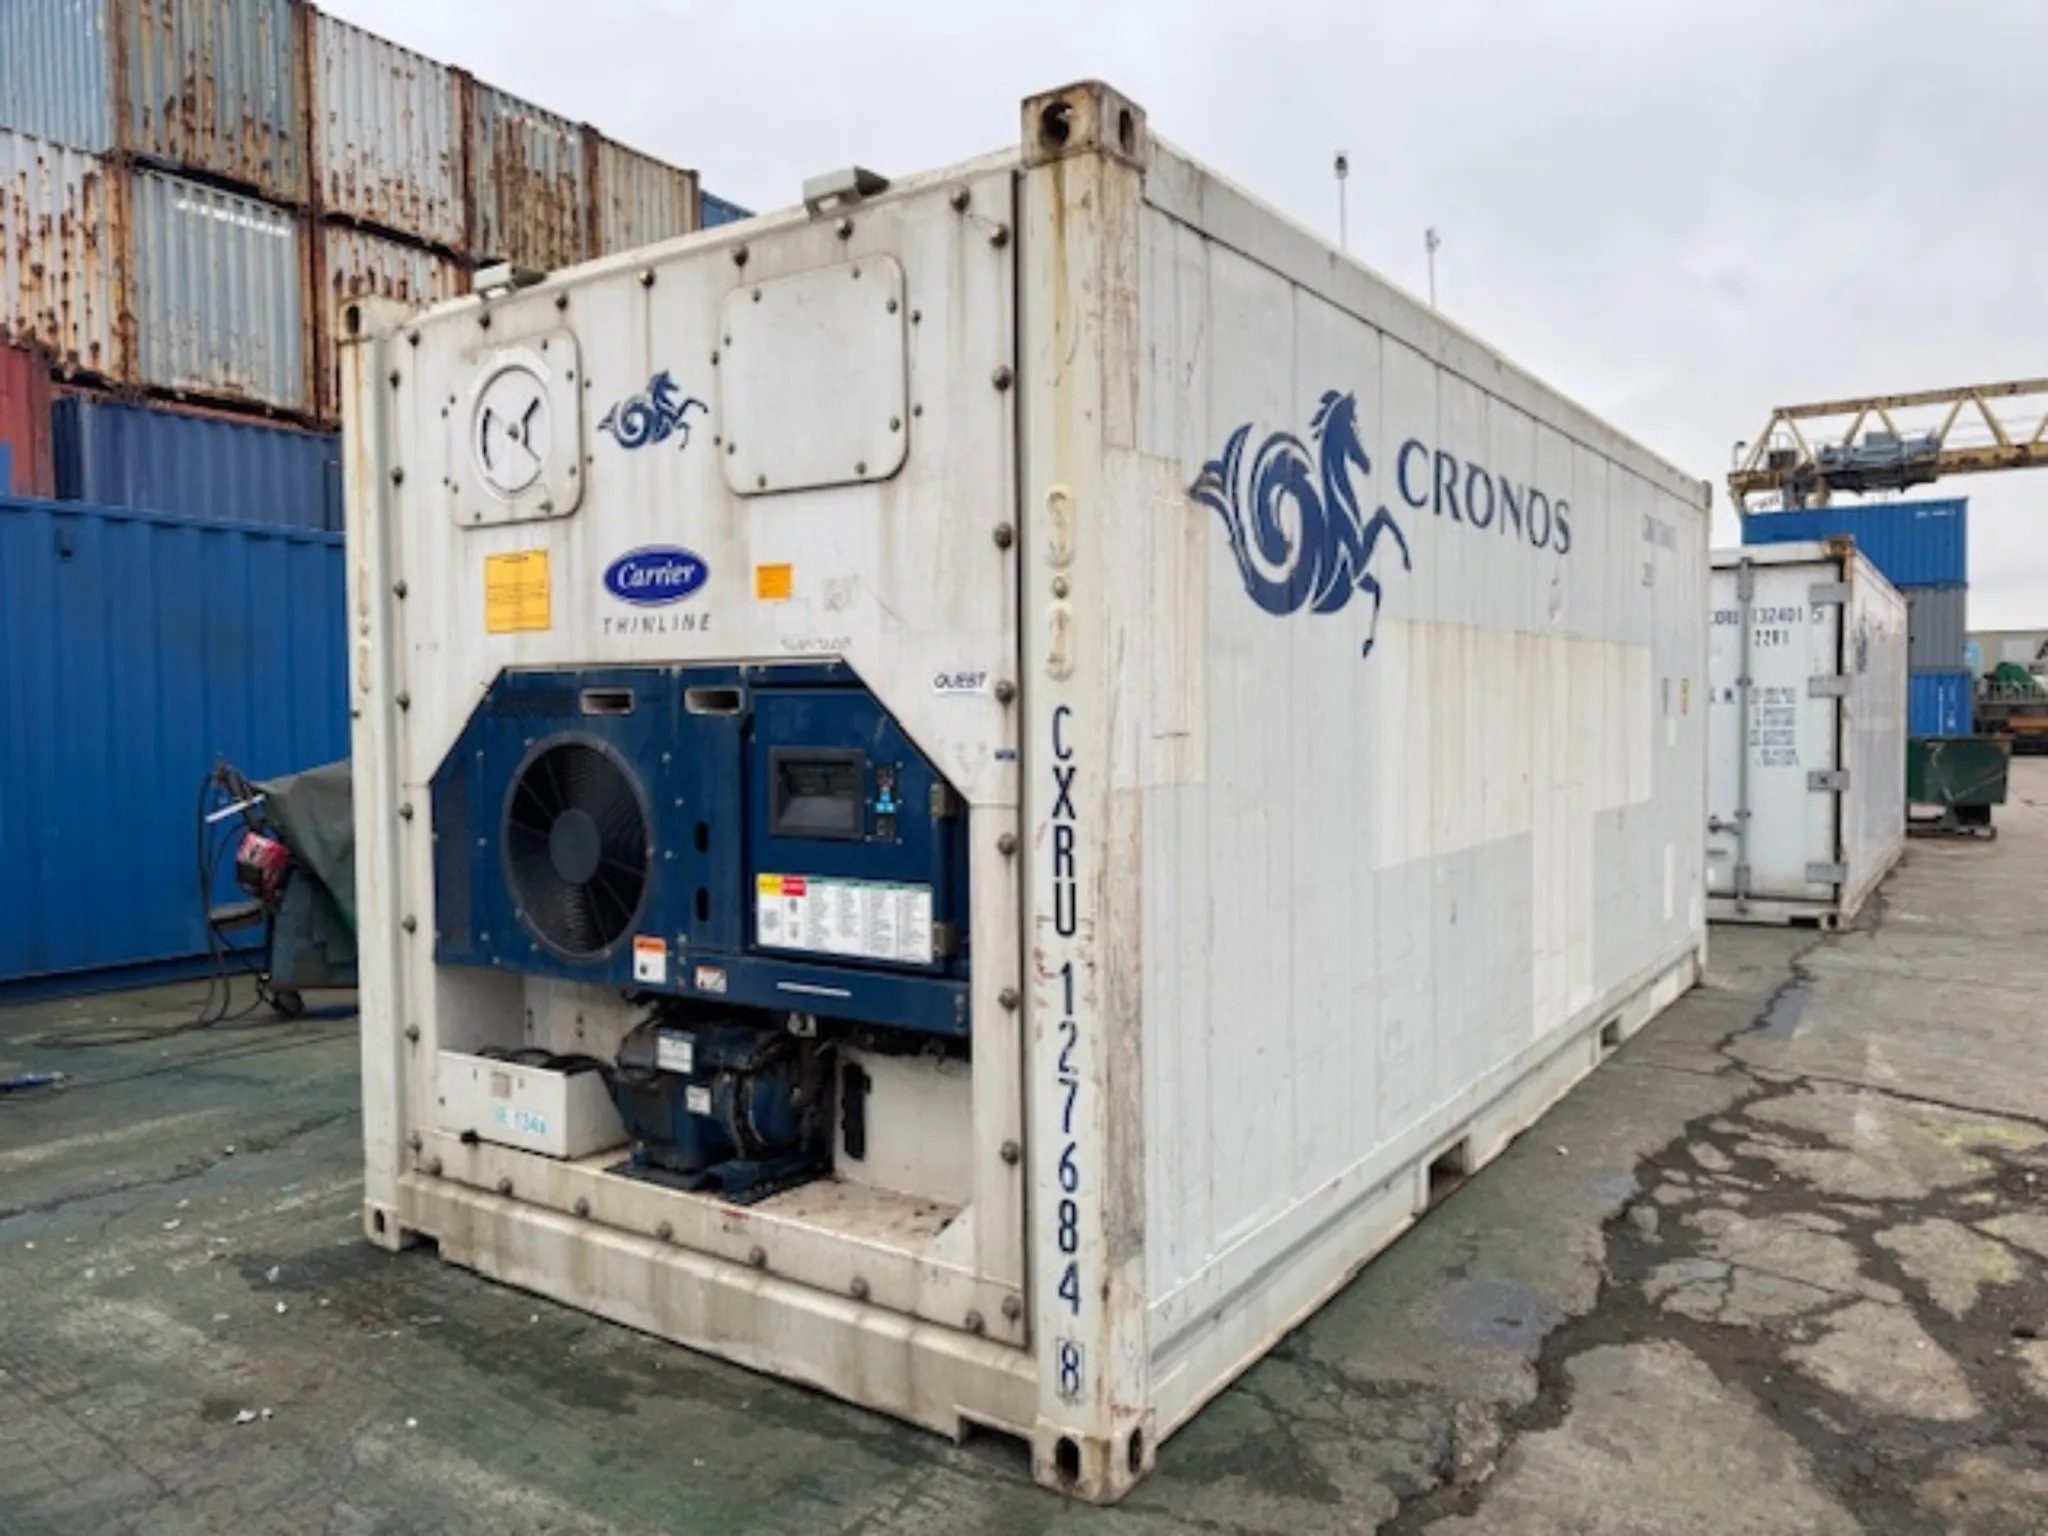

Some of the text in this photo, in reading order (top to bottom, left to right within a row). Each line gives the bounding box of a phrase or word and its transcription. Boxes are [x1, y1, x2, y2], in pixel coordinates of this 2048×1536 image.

[1397, 438, 1571, 554] CRONOS
[617, 560, 695, 589] Carrier
[603, 613, 711, 635] THINLINE
[1052, 705, 1080, 1397] CXRU 127684 8
